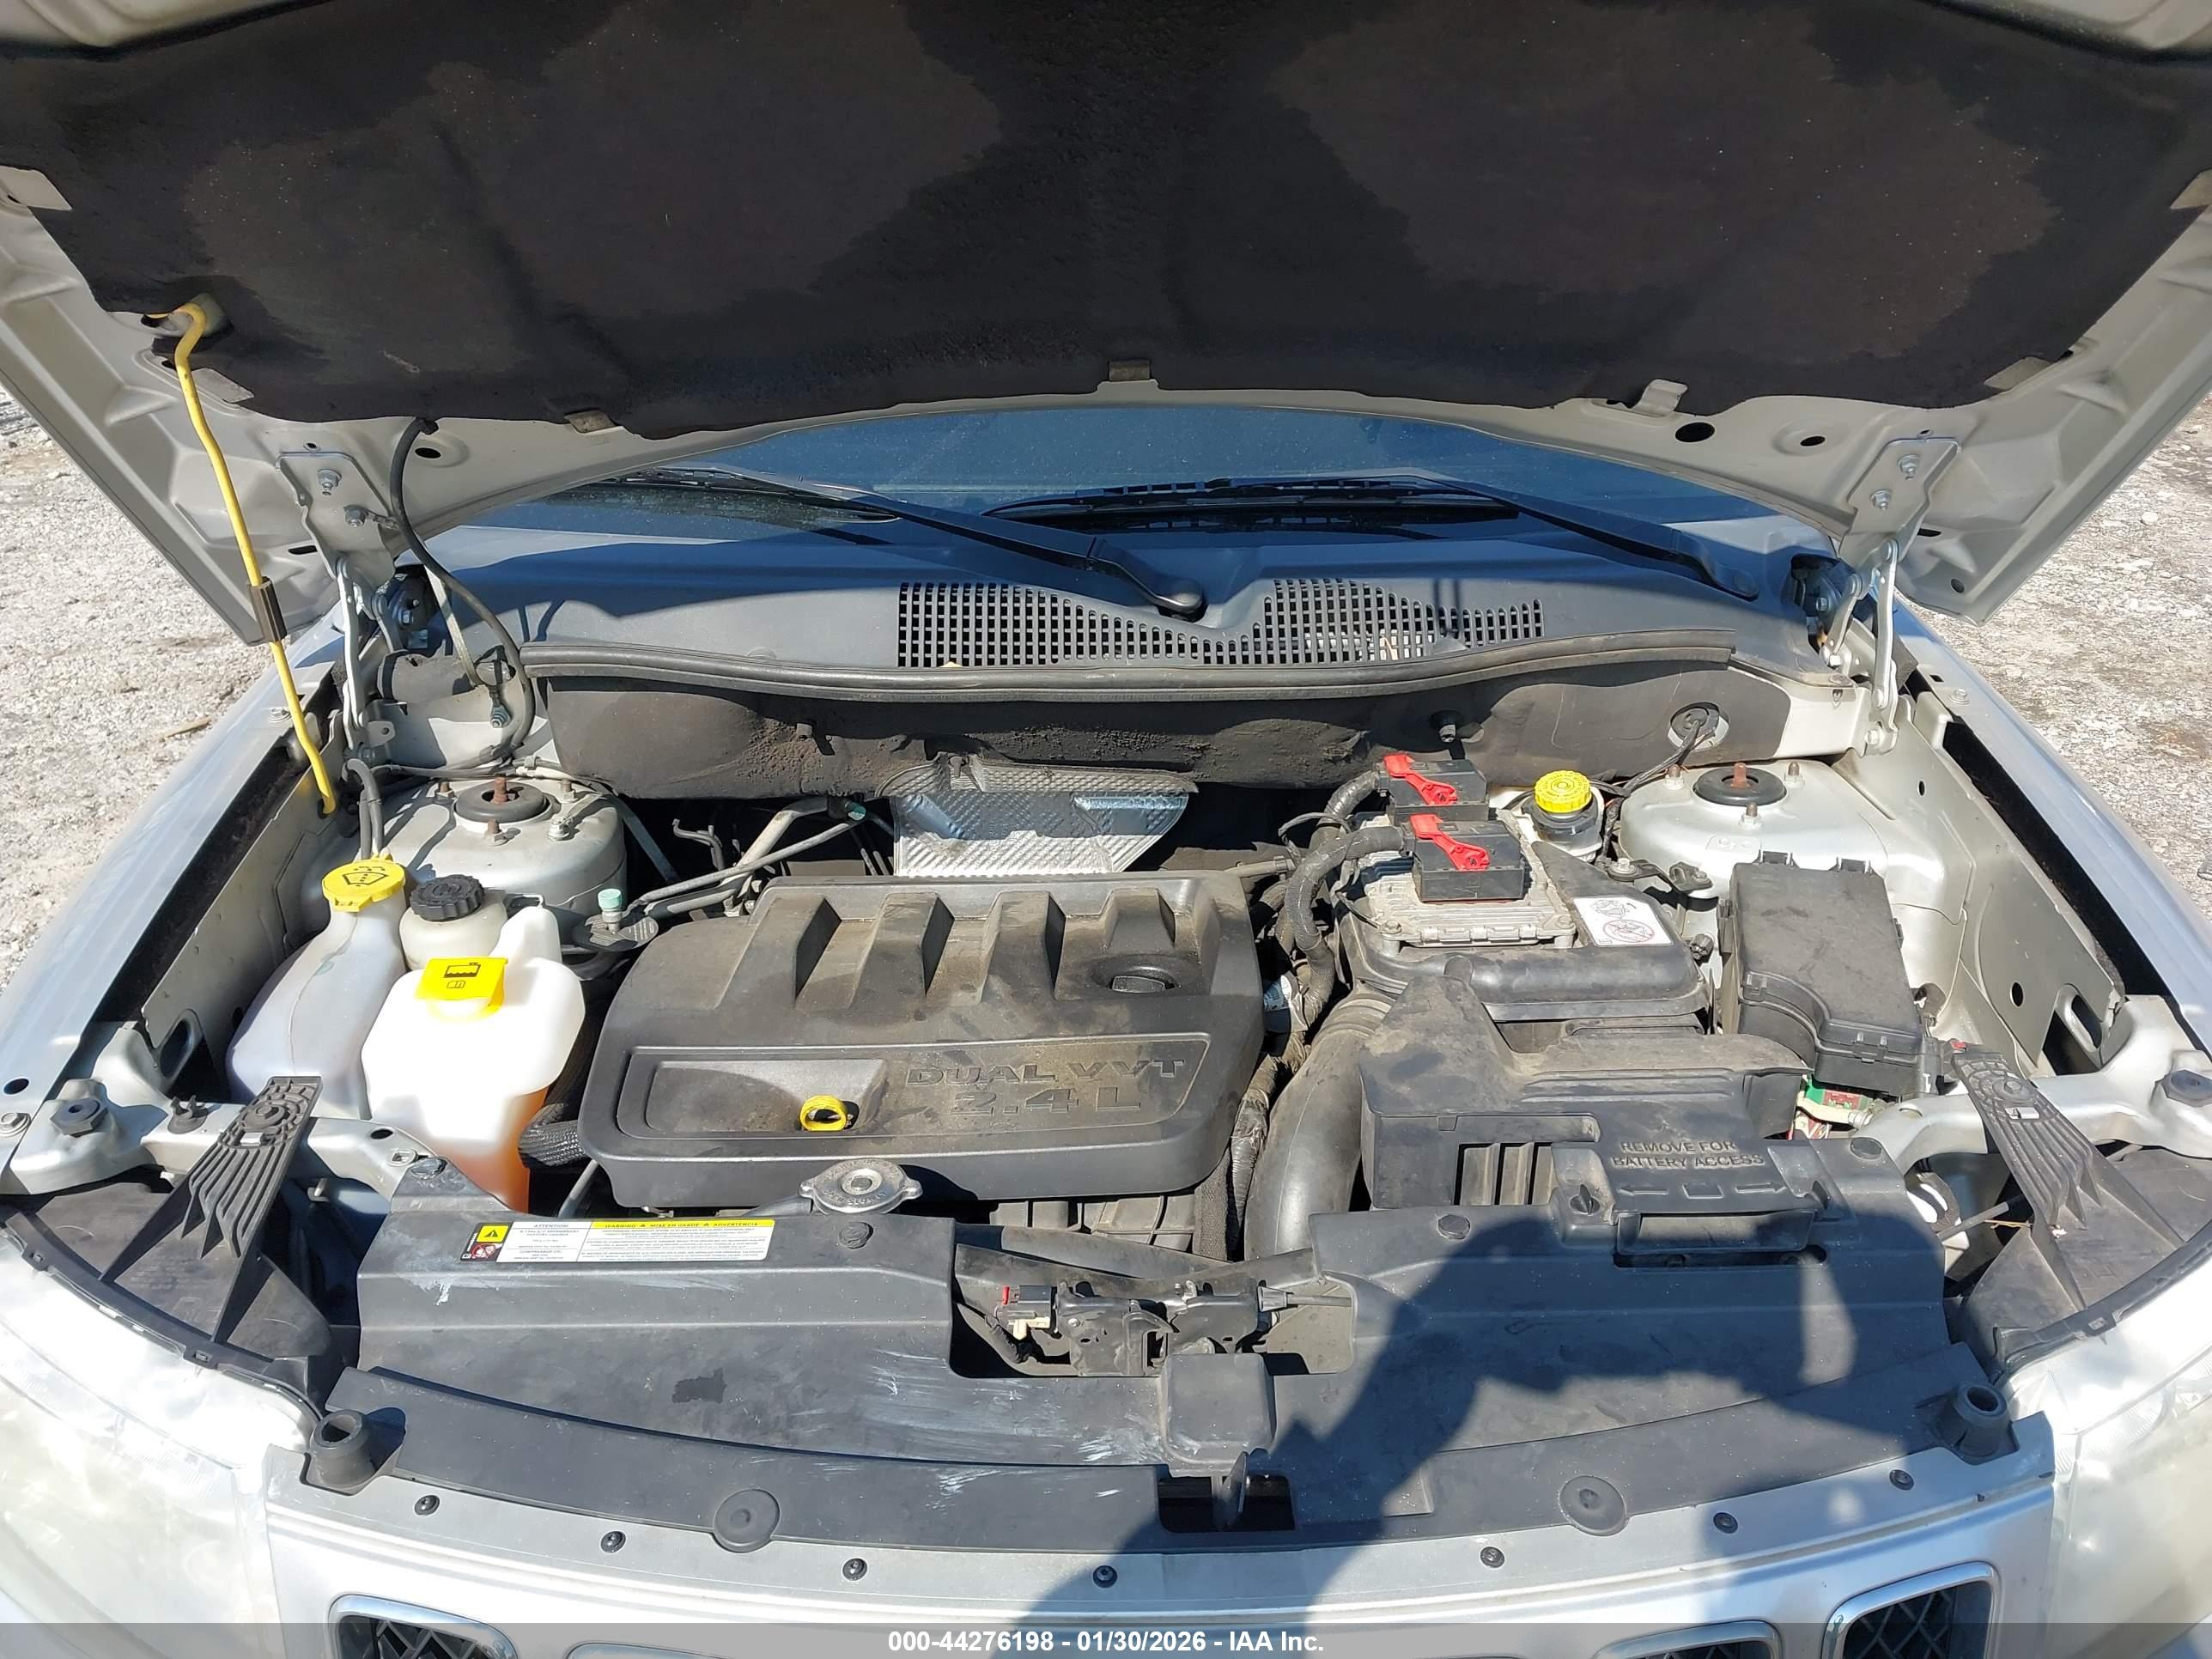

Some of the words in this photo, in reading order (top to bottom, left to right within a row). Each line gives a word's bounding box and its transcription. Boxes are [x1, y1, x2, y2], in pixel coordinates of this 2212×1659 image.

[907, 1063, 1057, 1086] DUAL
[1068, 1057, 1185, 1082] VVT
[1620, 1139, 1696, 1155] REMOVE
[1698, 1139, 1737, 1153] FOR
[1612, 1155, 1689, 1169] BATTERY
[1693, 1153, 1765, 1170] ACCESS
